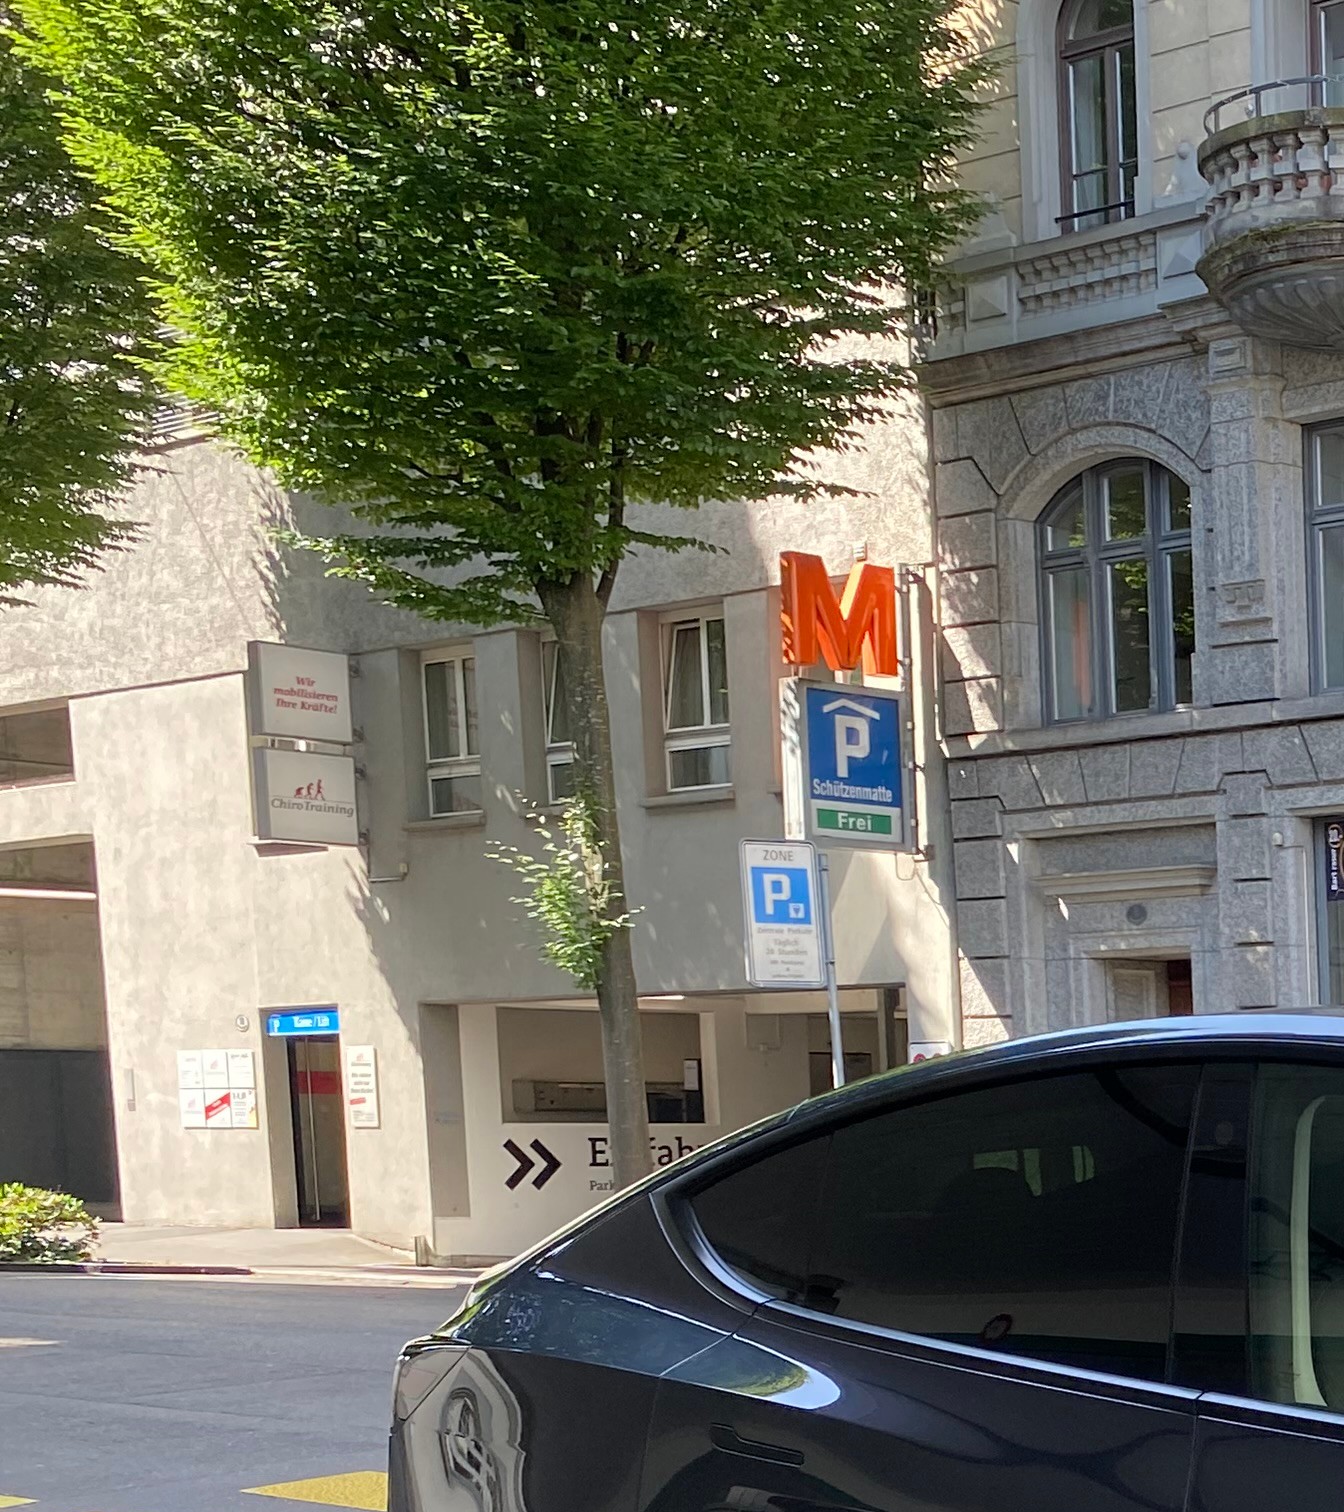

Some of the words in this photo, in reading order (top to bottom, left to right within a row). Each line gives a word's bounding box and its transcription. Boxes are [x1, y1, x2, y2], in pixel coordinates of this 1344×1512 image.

[780, 551, 898, 677] M
[295, 676, 316, 687] Wir
[273, 687, 338, 702] mobilisieren
[276, 698, 297, 709] Ihre
[300, 701, 337, 714] Kräfte!
[835, 714, 869, 777] P
[812, 778, 892, 803] Schützenmatte
[271, 798, 354, 818] ChiroTraining
[837, 812, 872, 831] Frei
[763, 850, 794, 861] ZONE
[763, 873, 791, 915] P
